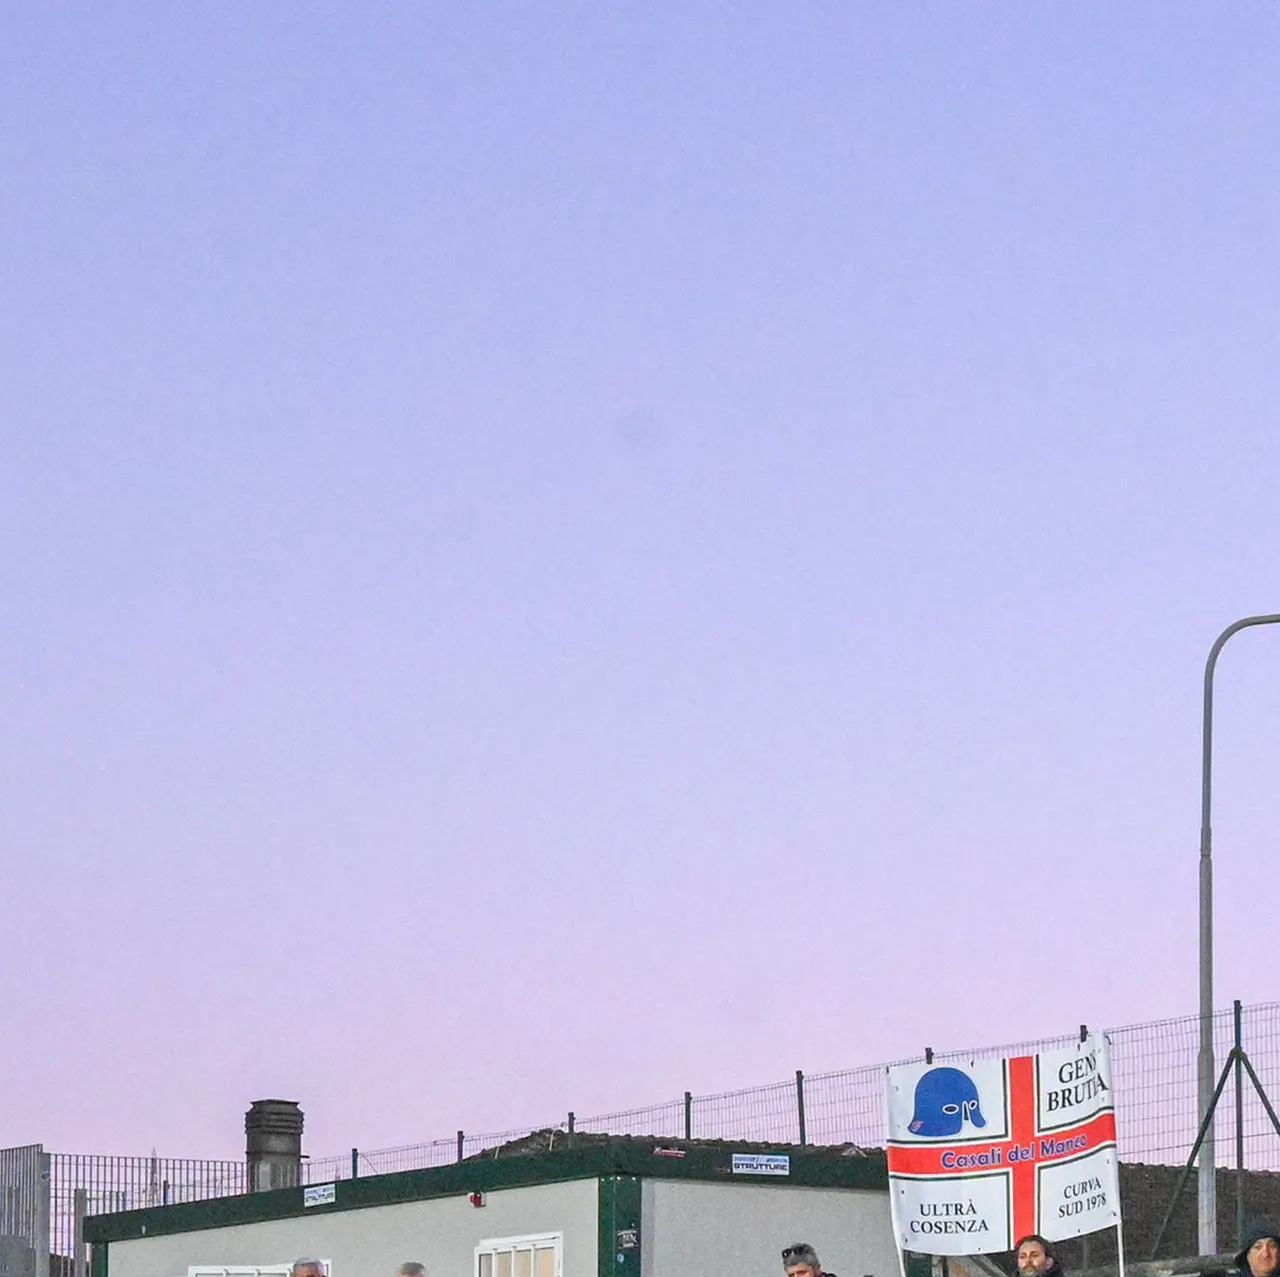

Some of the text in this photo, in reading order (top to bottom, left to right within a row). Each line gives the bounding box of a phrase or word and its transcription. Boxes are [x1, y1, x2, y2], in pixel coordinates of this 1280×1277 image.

[1047, 1073, 1109, 1112] BRUTIA
[941, 1148, 1001, 1169] Casali
[1008, 1144, 1035, 1162] del
[1063, 1176, 1102, 1199] CURVA
[920, 1200, 977, 1217] ULTRÀ
[1058, 1192, 1107, 1218] SUD 1978
[910, 1220, 989, 1234] COSENZA
